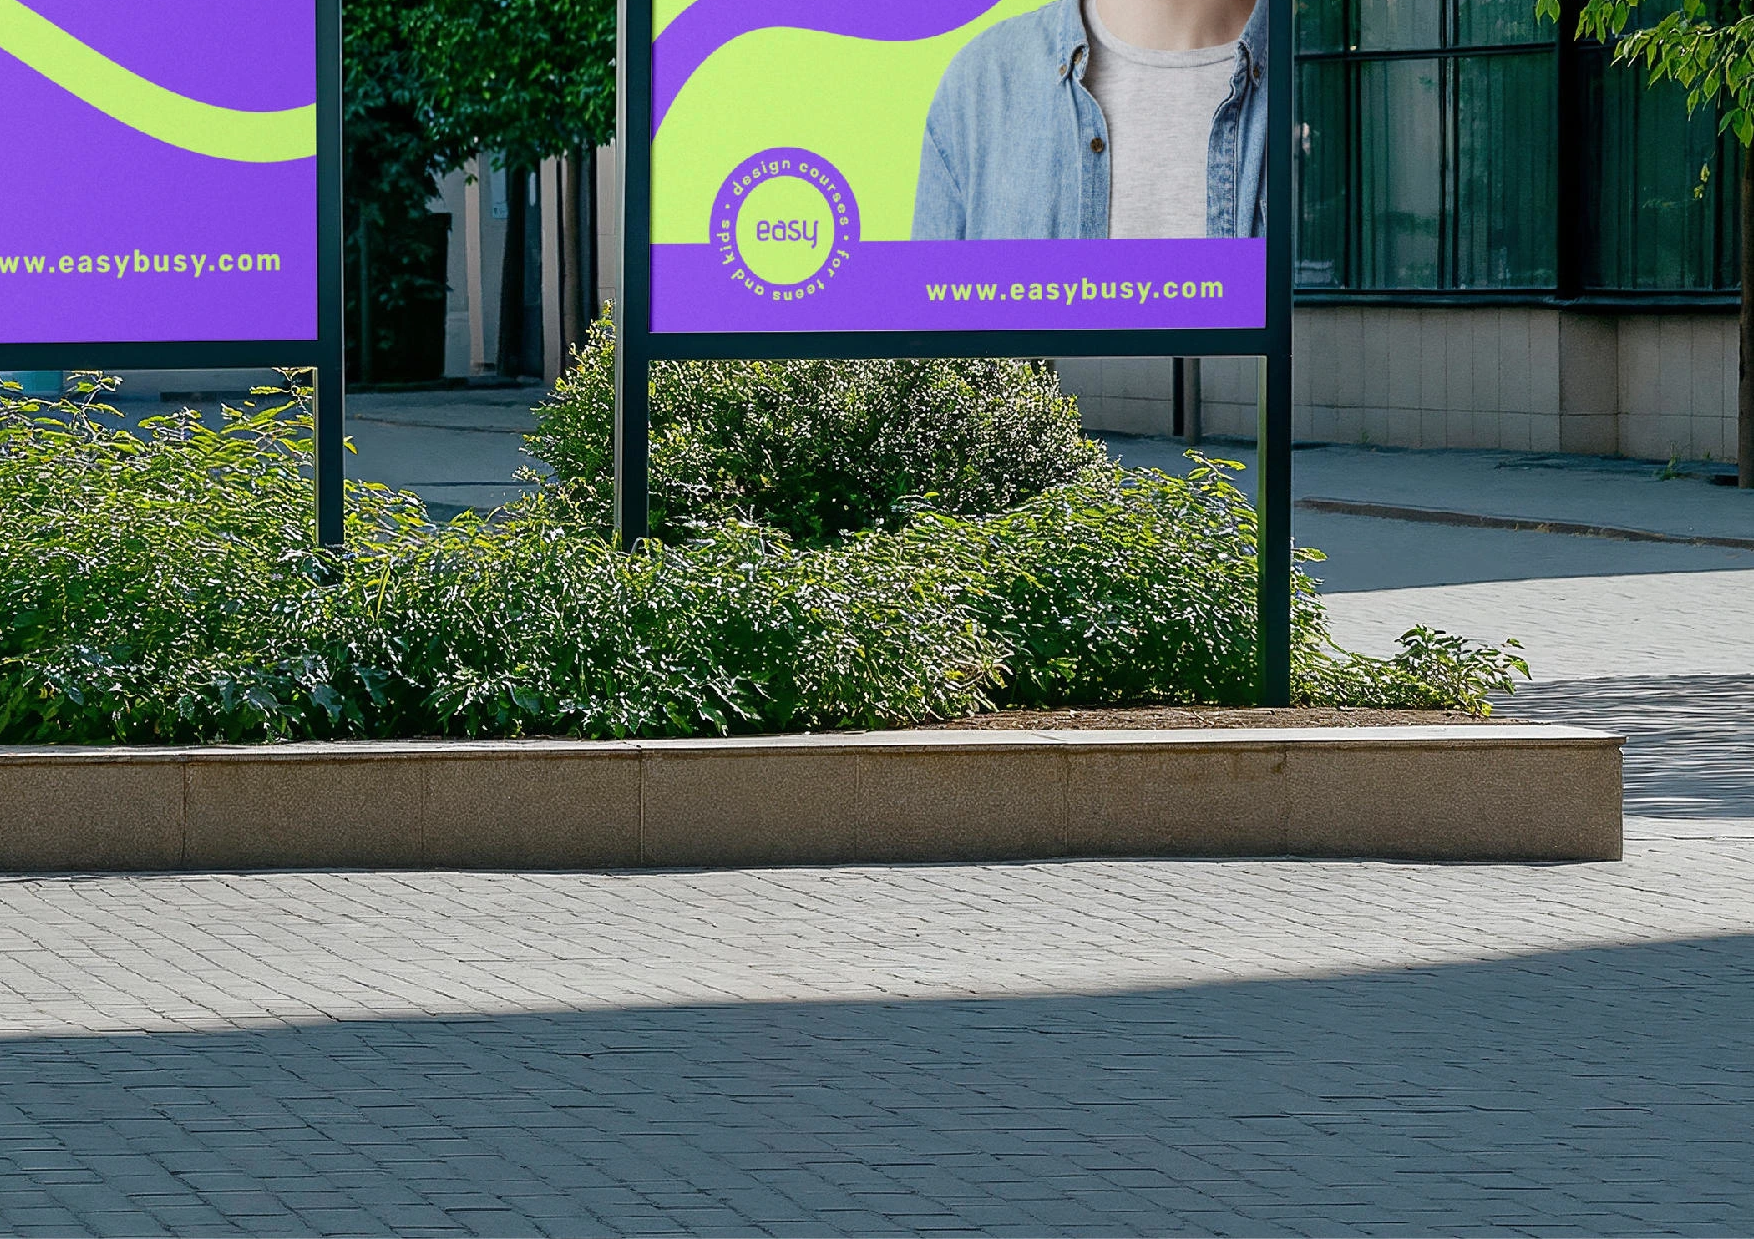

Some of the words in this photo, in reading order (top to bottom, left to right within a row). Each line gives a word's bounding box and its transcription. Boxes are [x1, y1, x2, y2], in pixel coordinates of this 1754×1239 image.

[733, 160, 791, 196] design
[799, 162, 850, 226] courses
[716, 219, 736, 265] kids
[756, 219, 819, 249] easy
[828, 249, 850, 278] for
[730, 268, 765, 296] and
[772, 279, 825, 301] teens
[926, 278, 1223, 304] www.easybusy.com
